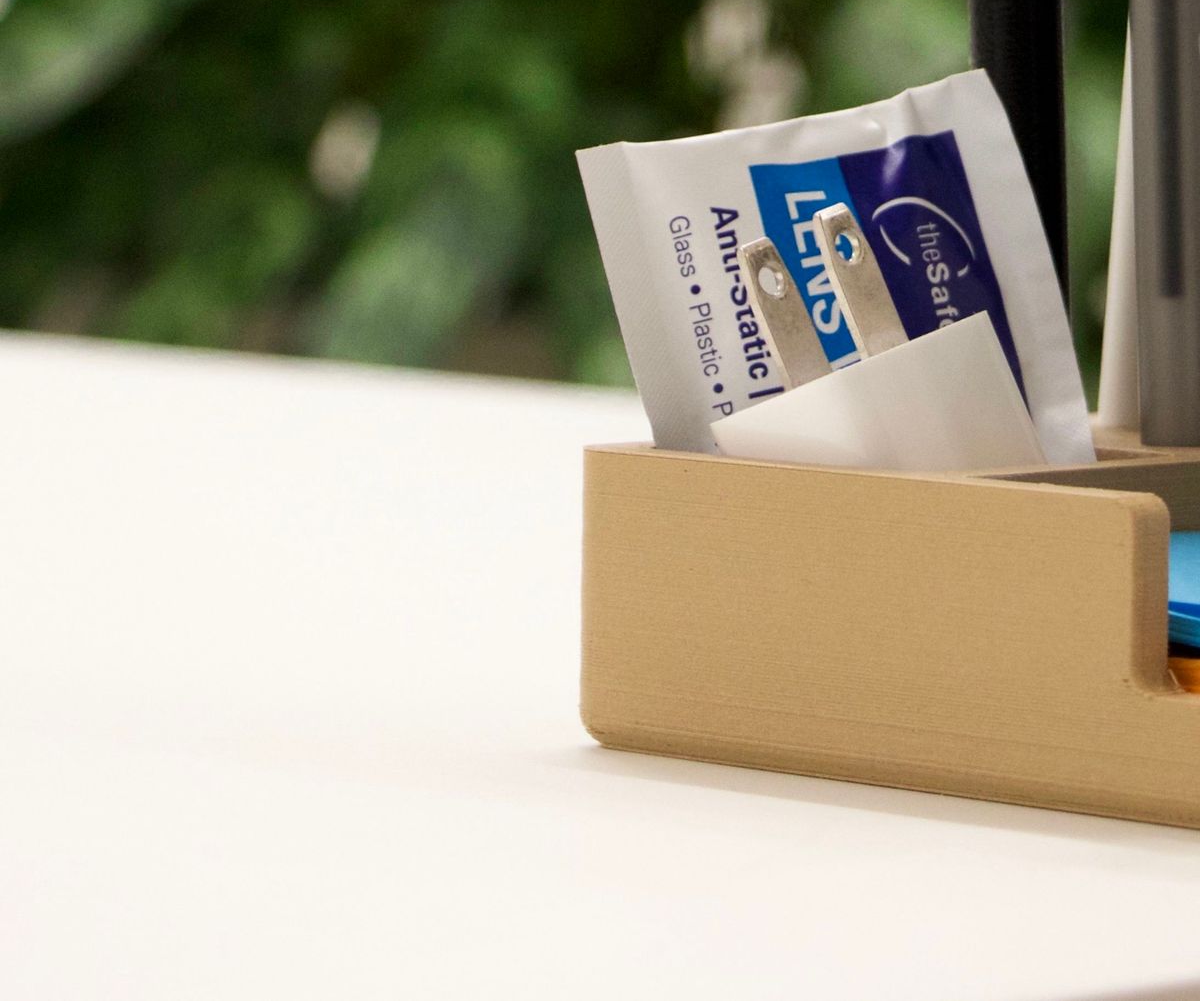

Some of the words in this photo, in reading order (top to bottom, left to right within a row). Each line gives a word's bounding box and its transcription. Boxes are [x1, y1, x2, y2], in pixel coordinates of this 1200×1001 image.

[669, 215, 696, 278] Glass
[689, 302, 723, 378] Plastic
[710, 206, 772, 381] Anti-Static
